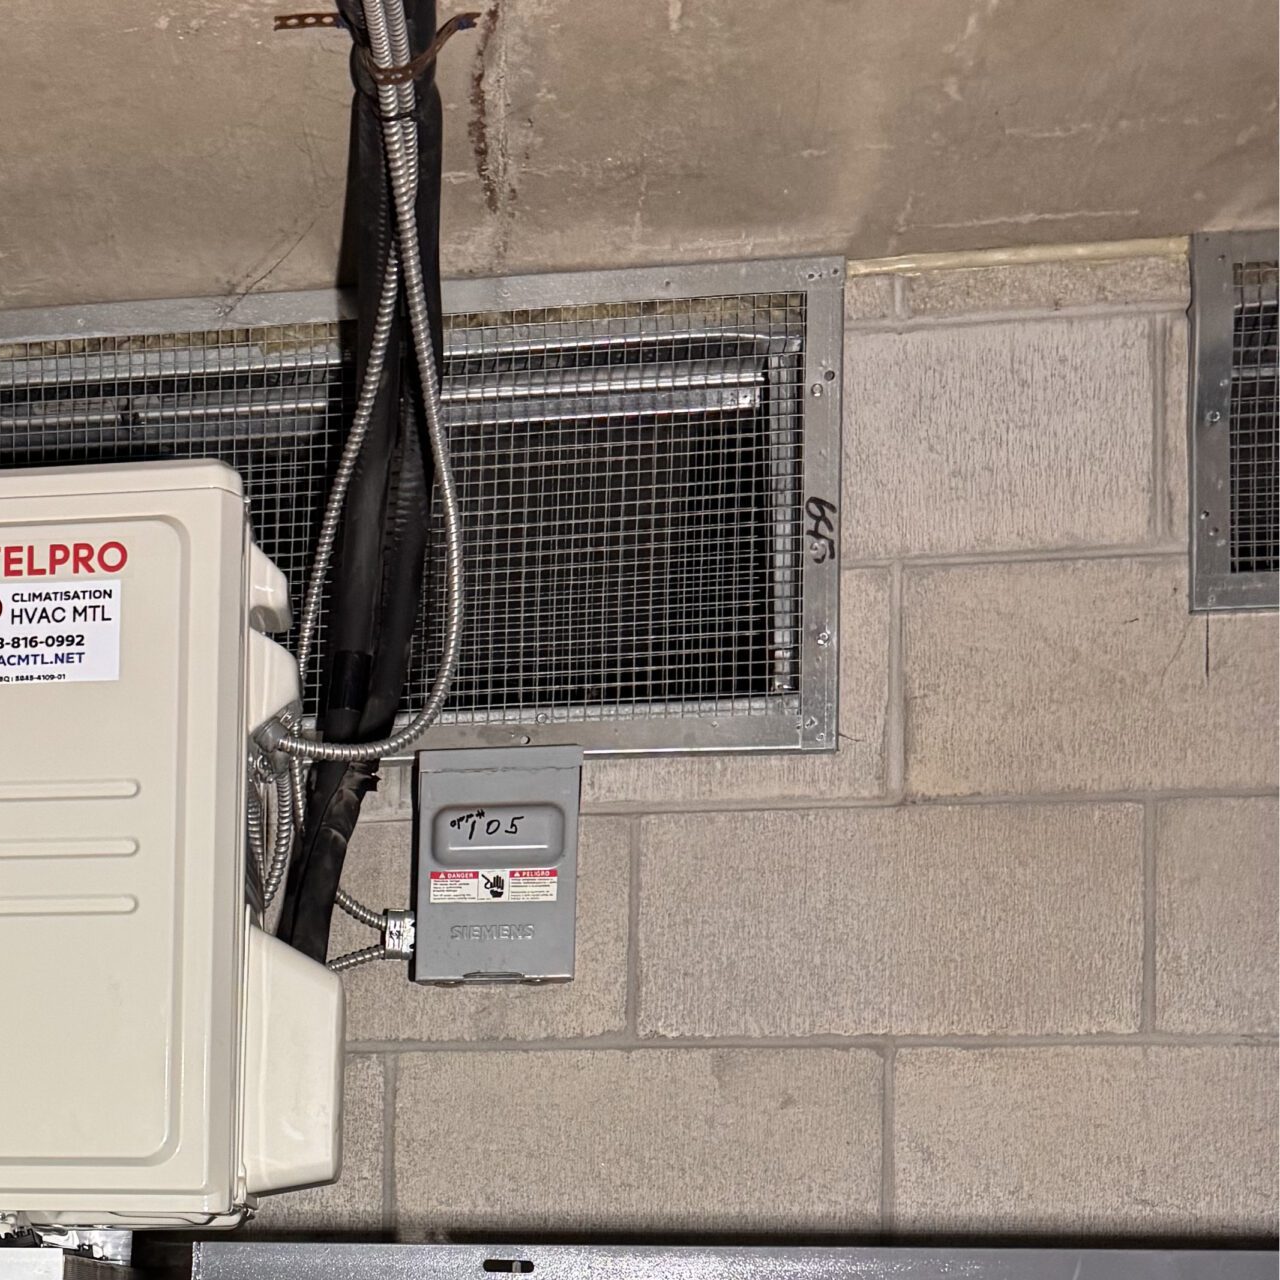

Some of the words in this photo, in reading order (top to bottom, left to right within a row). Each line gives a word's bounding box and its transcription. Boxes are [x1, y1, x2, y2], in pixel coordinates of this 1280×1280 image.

[11, 589, 113, 603] CLIMATISATION
[10, 606, 66, 625] HVAC
[72, 605, 112, 623] MTL
[469, 815, 525, 841] 105
[450, 924, 535, 941] SIEMENS
